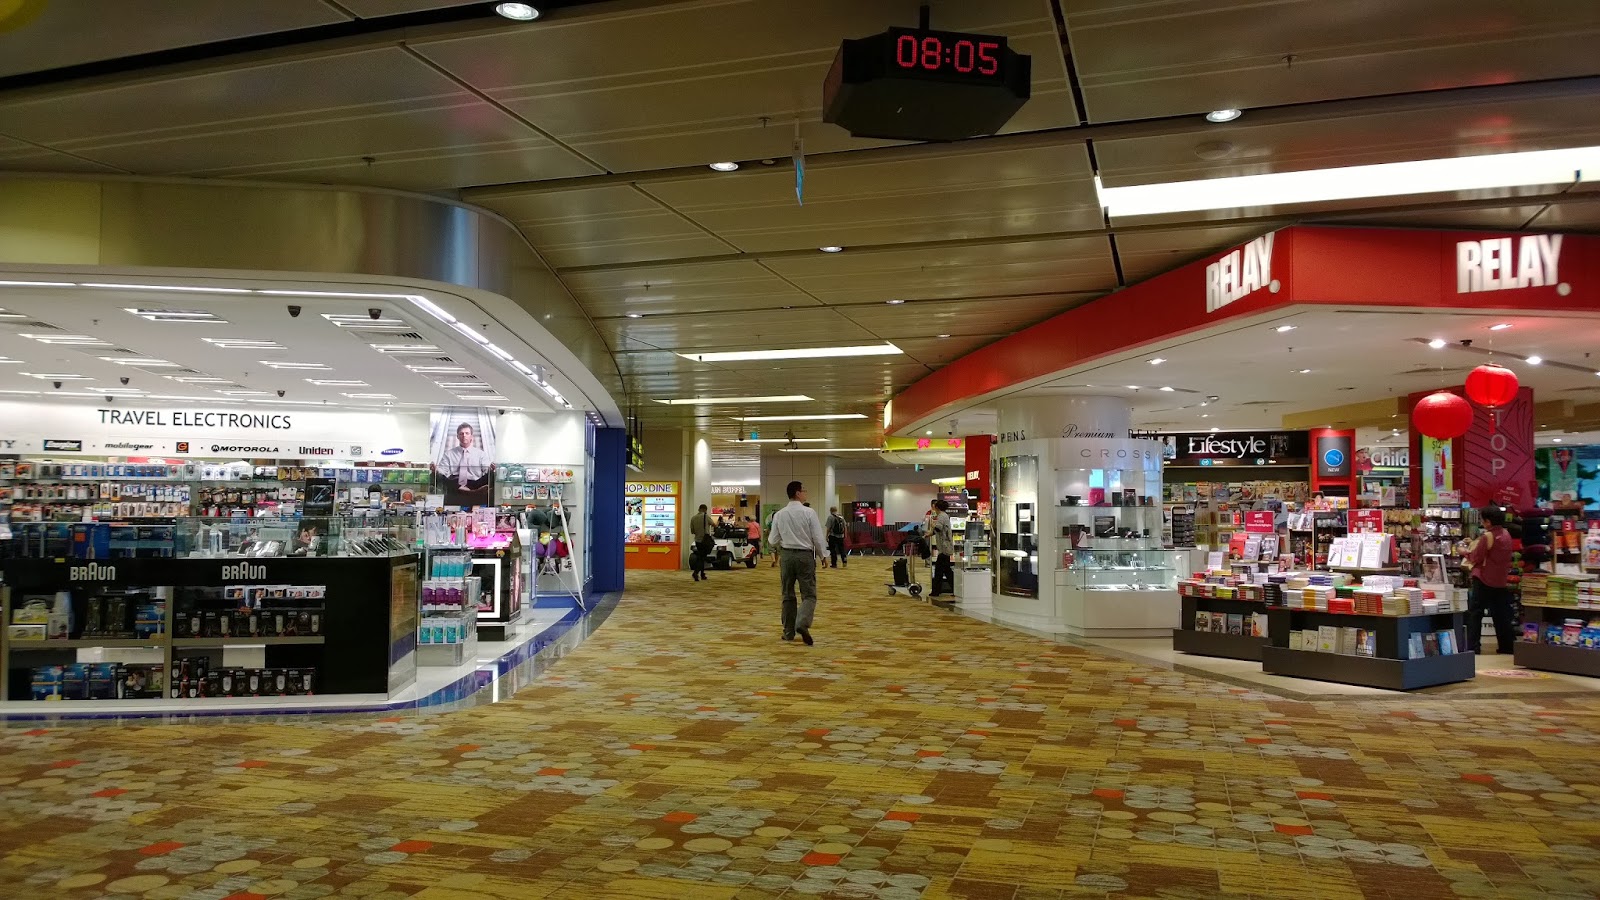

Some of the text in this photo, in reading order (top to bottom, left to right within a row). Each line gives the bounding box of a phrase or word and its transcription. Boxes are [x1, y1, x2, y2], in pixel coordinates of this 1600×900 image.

[896, 35, 998, 75] 08:05
[97, 409, 291, 429] TRAVEL ELECTRONICS
[1001, 430, 1025, 443] PENS
[1062, 425, 1115, 439] Premium
[105, 442, 153, 451] mobilegear
[299, 446, 334, 455] Uniden
[1188, 434, 1266, 458] Lifestyle
[1080, 448, 1151, 459] CROSS
[625, 484, 642, 492] HOP
[649, 484, 673, 493] DINE
[70, 562, 116, 581] BRAUN
[222, 561, 266, 580] BRAUN
